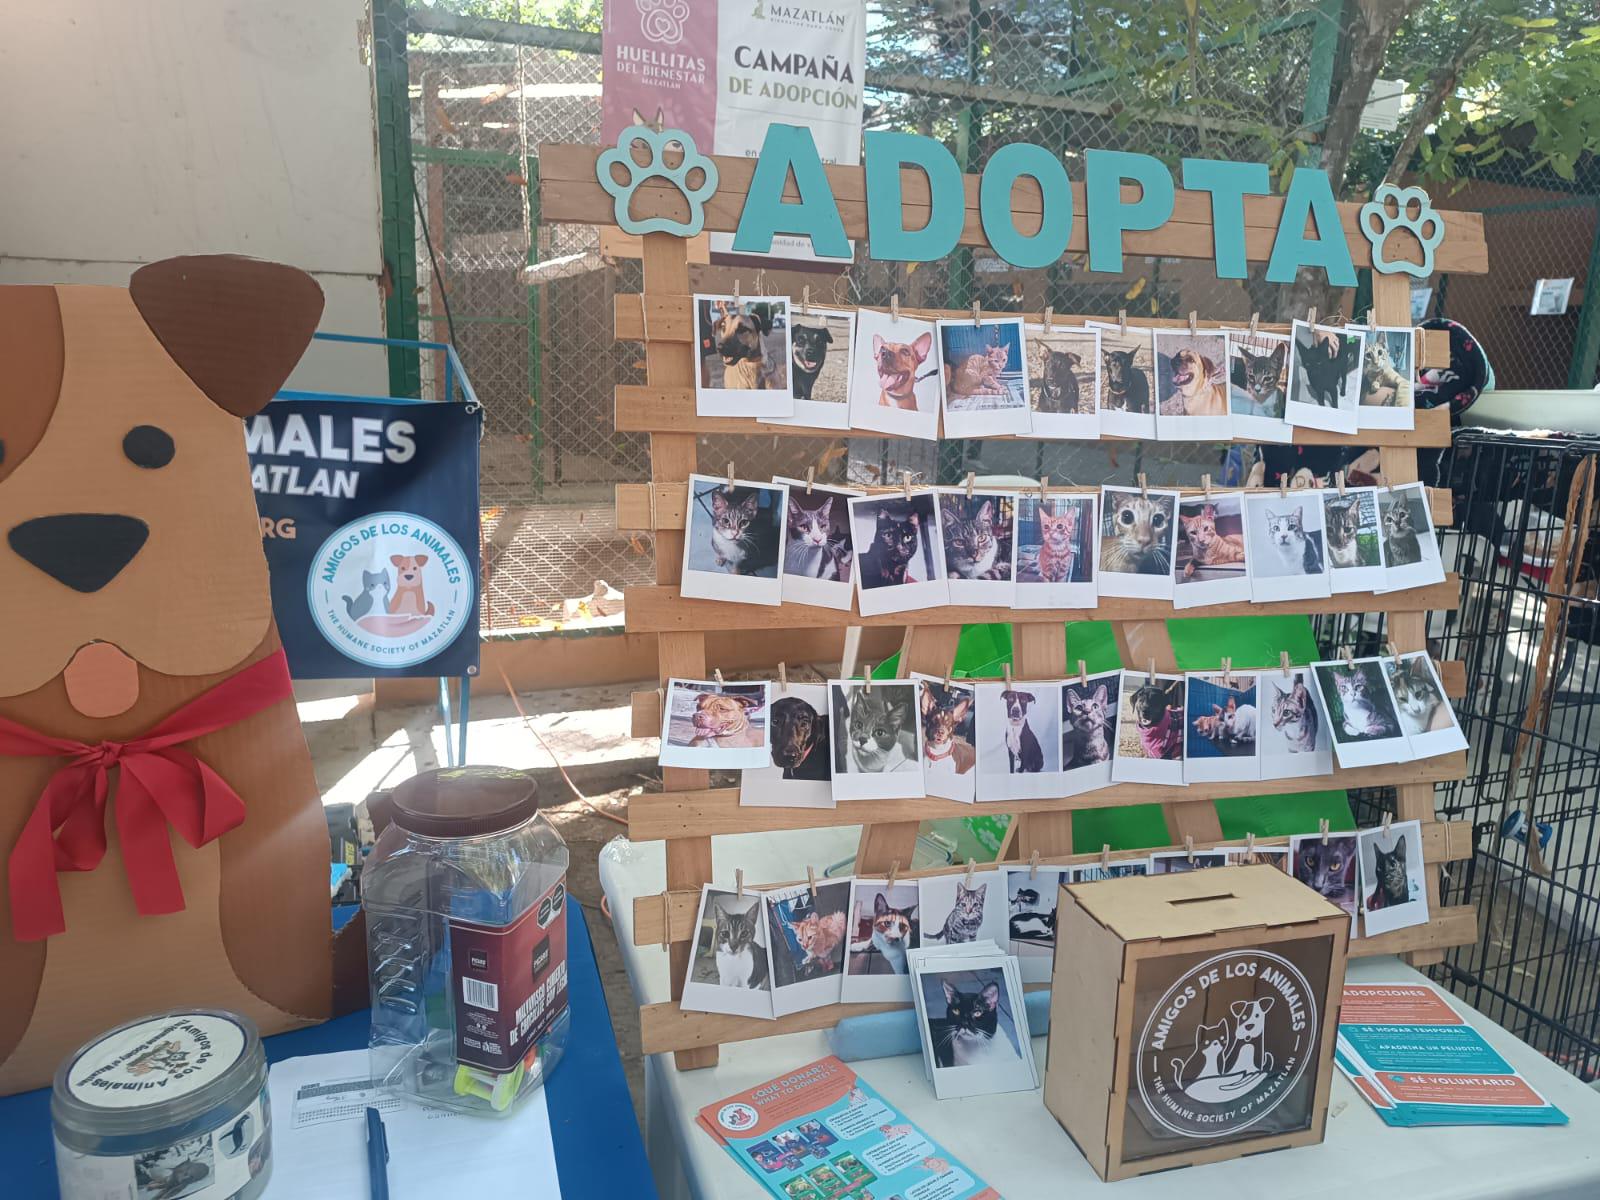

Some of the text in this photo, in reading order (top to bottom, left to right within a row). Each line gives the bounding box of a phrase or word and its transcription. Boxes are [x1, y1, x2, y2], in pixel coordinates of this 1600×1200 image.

[770, 4, 845, 26] MAZATLÁN
[616, 45, 706, 72] HUELLITAS
[616, 61, 705, 84] DEL BIENESTAR
[734, 45, 854, 84] CAMPAÑA
[729, 76, 857, 109] DE ADOPCIÓN
[731, 122, 1358, 287] ADOPTA
[322, 523, 461, 585] AMIGOS DE LOS ANIMALES
[327, 609, 456, 655] THE HUMANE SOCIETY OF MAZATLAN
[1151, 985, 1197, 1050] AMIGOS
[1198, 968, 1220, 990] DE
[1225, 962, 1258, 979] LOS
[1259, 966, 1306, 1032] ANIMALES
[180, 1023, 213, 1050] Amigos
[196, 1052, 213, 1065] de
[91, 1077, 168, 1091] Animales
[1153, 1056, 1296, 1123] THE HUMANE SOCIETY OF MAZATLAN
[1409, 1075, 1516, 1086] SÉ VOLUNTARIO
